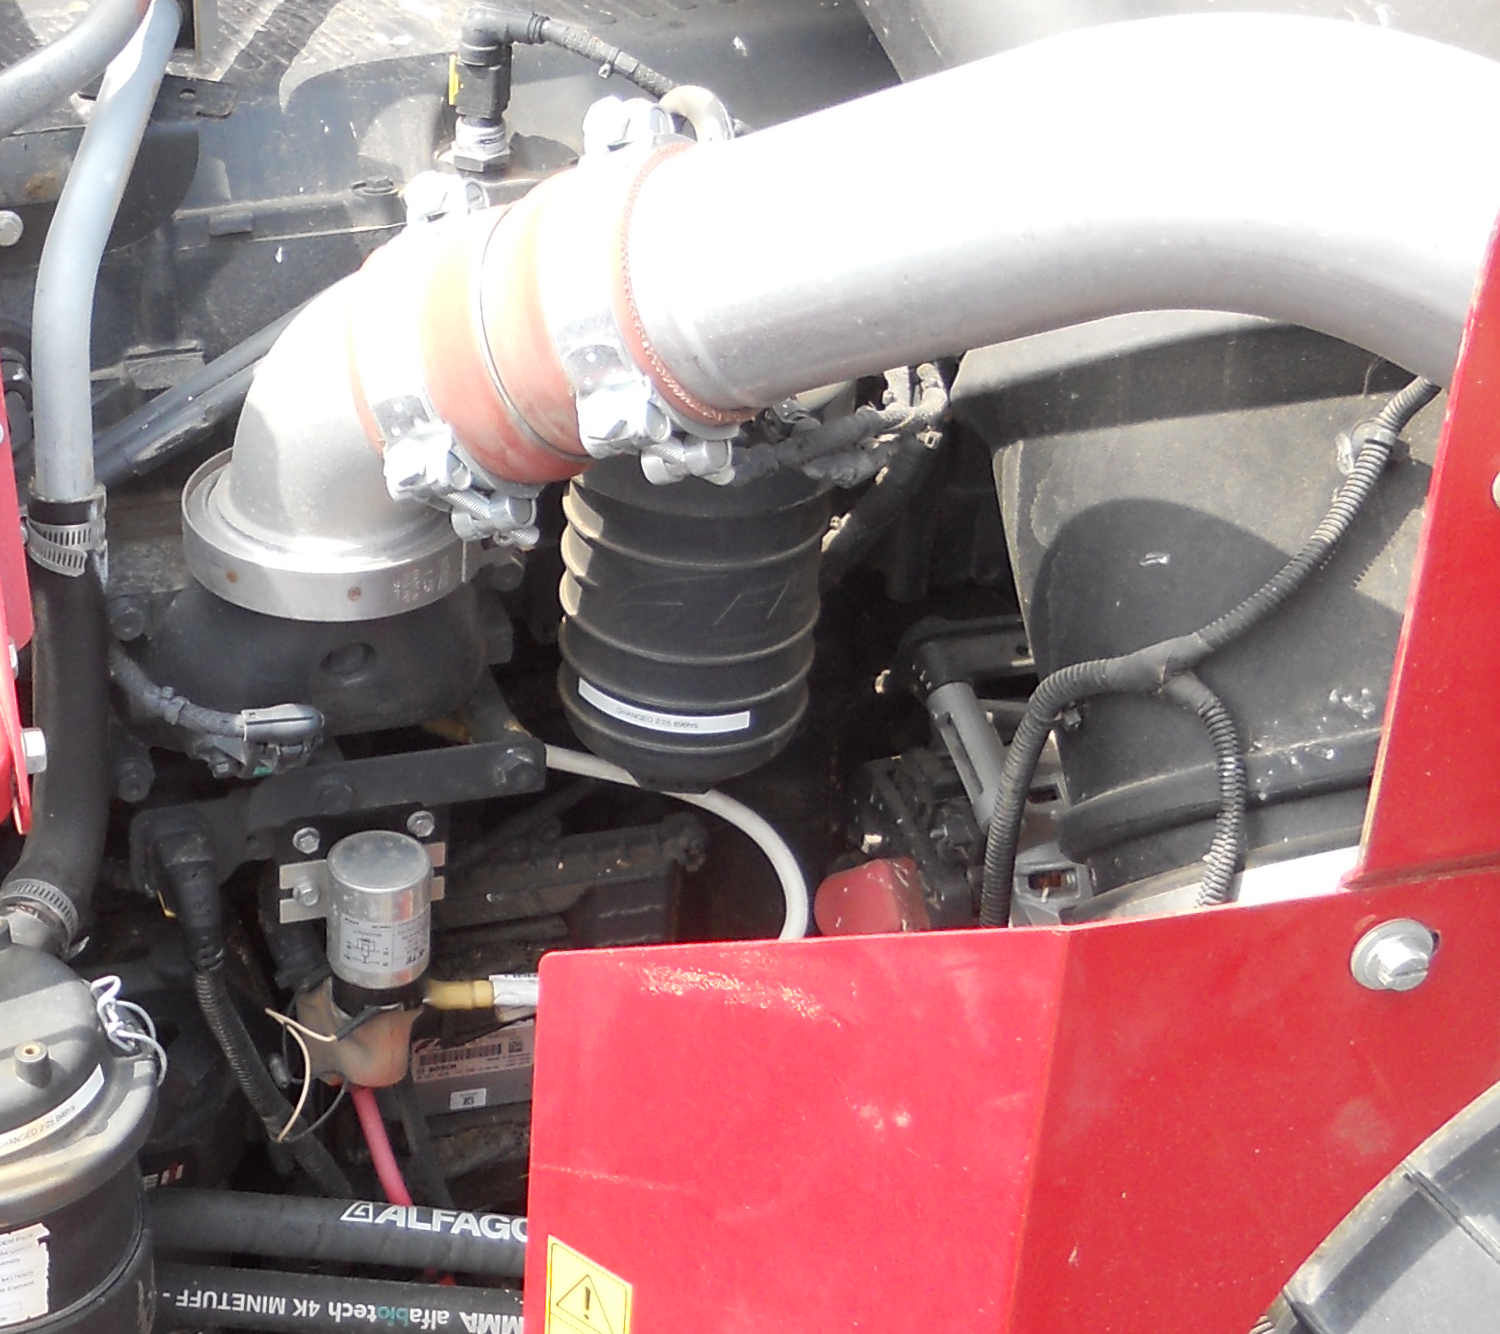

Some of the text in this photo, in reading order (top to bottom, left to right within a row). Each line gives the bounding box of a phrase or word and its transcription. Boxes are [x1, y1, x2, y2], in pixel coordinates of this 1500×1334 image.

[176, 1290, 287, 1315] MINETUFF
[292, 1298, 320, 1317] 4K
[328, 1302, 449, 1331] alfabiotech
